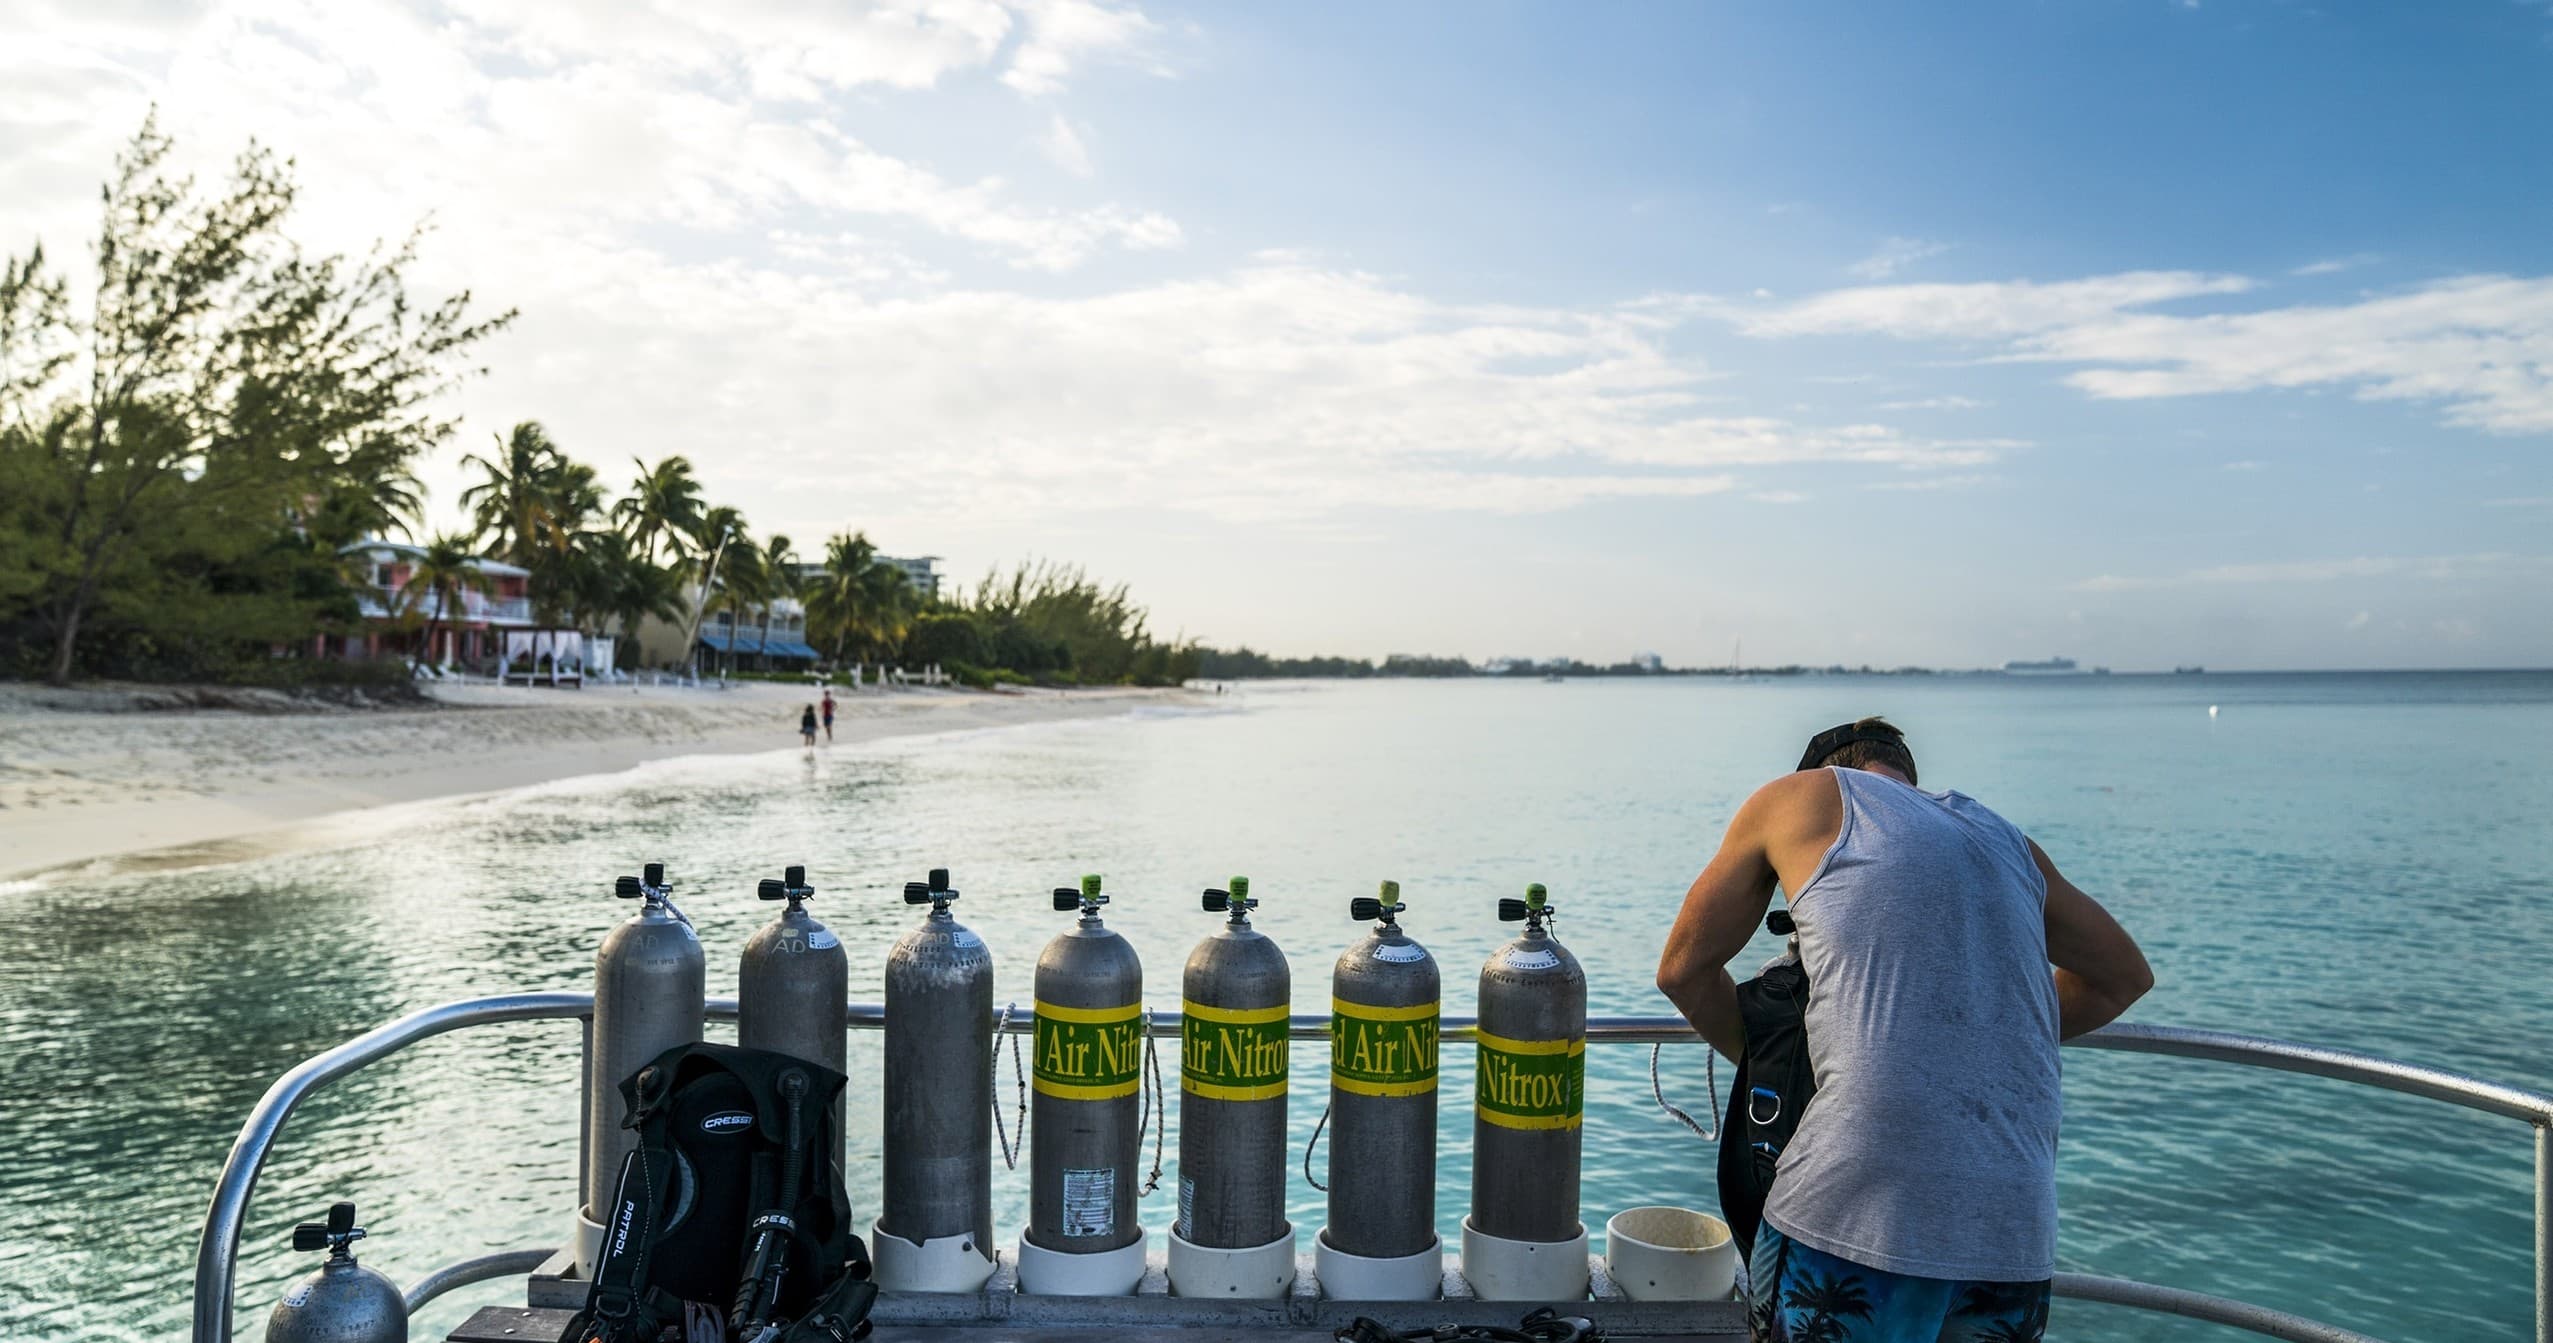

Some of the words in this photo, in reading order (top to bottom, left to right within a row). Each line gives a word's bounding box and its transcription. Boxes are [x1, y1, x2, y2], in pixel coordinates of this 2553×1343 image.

[771, 939, 806, 954] AD
[1044, 1024, 1090, 1077] Air
[1183, 1019, 1211, 1074] Air
[1350, 1023, 1398, 1074] Air
[1481, 1050, 1563, 1108] Nitrox
[704, 1115, 753, 1128] CRESSI
[612, 1200, 635, 1258] PATROL
